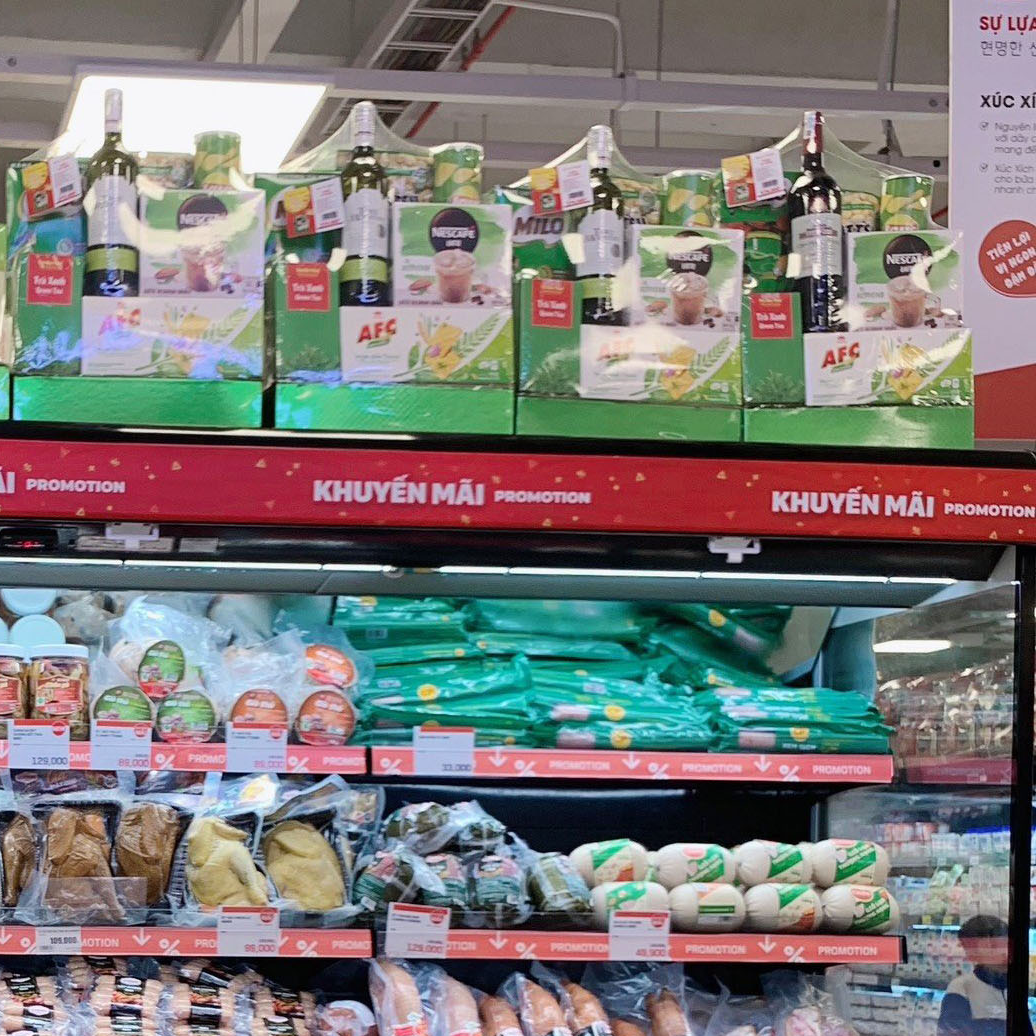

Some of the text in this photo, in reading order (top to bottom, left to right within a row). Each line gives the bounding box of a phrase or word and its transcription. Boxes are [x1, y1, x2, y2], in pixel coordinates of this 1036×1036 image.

[979, 16, 1003, 35] SỰ
[980, 40, 1022, 56] 현명한
[980, 92, 1015, 109] XÚC
[514, 215, 563, 236] MILO
[357, 318, 398, 343] AFC
[821, 341, 861, 370] AFC
[26, 478, 125, 494] PROMOTION
[313, 474, 591, 506] KHUYẾN MÃI PROMOTION
[771, 486, 1036, 518] KHUYẾN MÃI PROMOTION
[32, 757, 68, 767] 129,000
[549, 760, 610, 770] PROMOTION
[682, 764, 742, 773] PROMOTION
[812, 765, 871, 775] PROMOTION
[551, 943, 608, 953] PROMOTION
[686, 944, 746, 954] PROMOTION
[818, 946, 877, 955] PROMOTION
